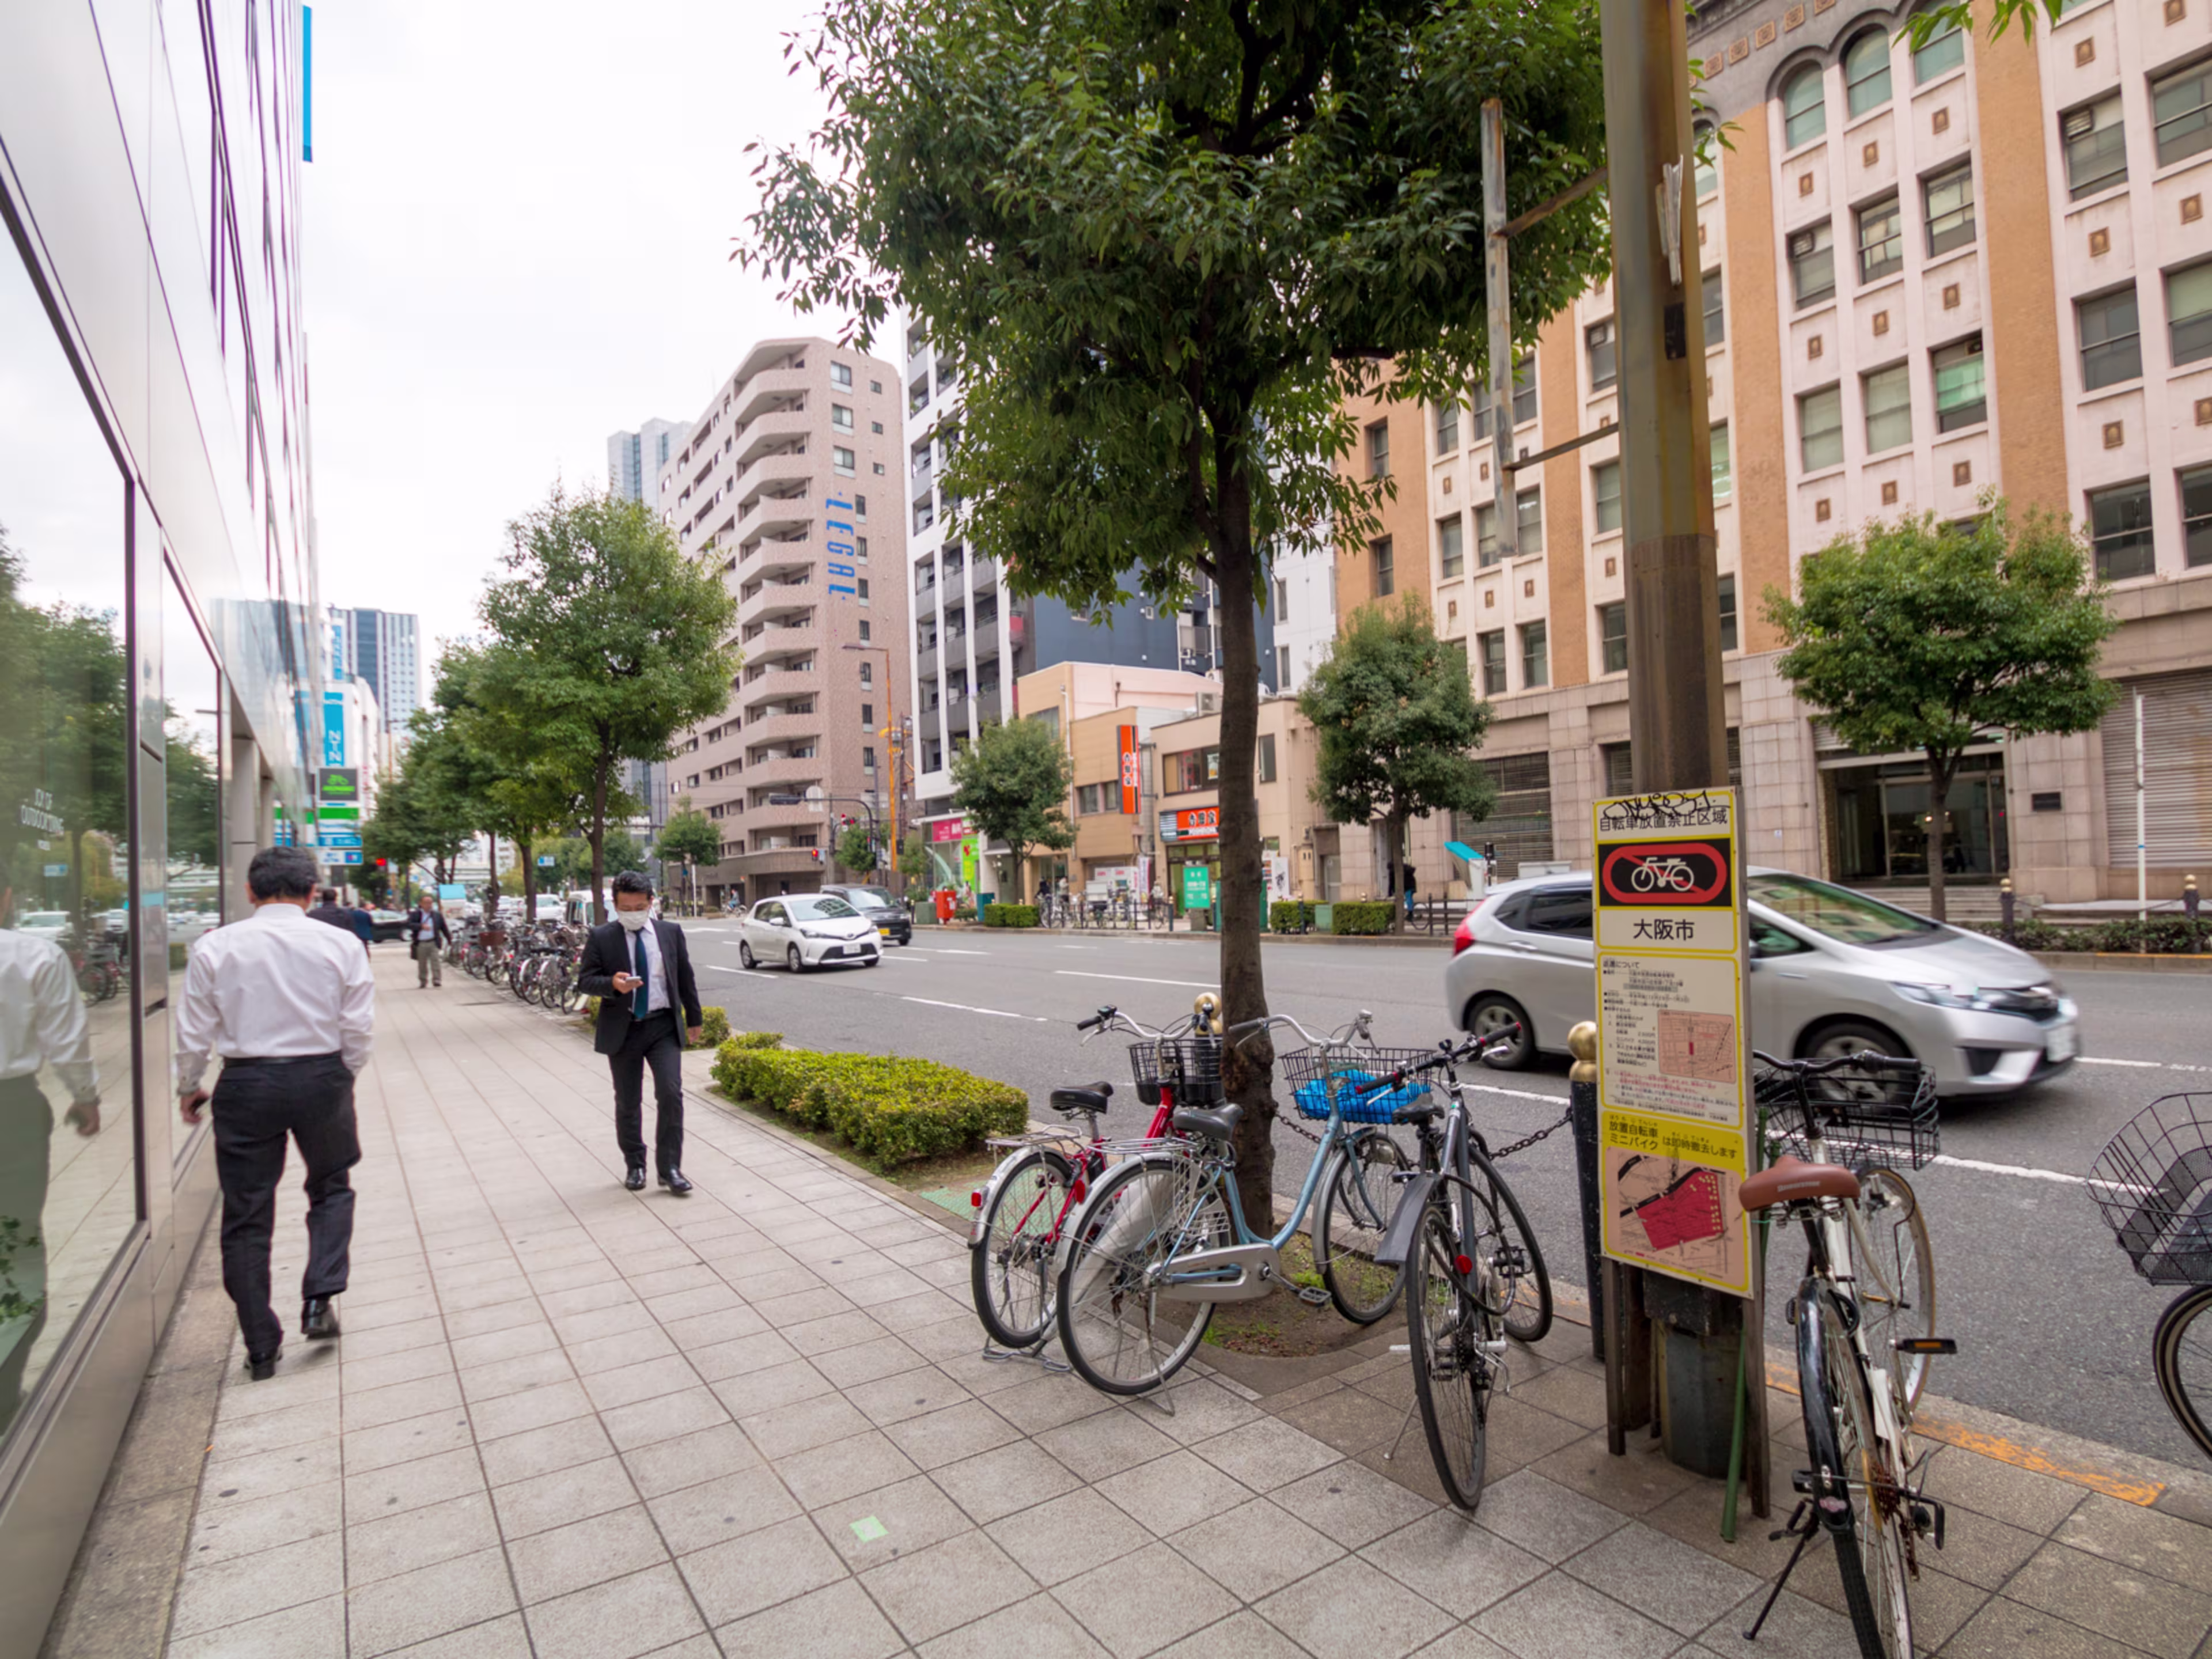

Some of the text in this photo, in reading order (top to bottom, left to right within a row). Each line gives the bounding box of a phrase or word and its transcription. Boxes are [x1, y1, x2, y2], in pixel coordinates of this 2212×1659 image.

[825, 498, 855, 595] LEGAL
[1600, 809, 1728, 831] 自転車放置禁止区域
[1633, 918, 1695, 941] 大阪市
[1609, 1121, 1659, 1138] 放置自転車
[1609, 1133, 1658, 1150] ミニバイク
[1662, 1135, 1738, 1159] は即時撤去します
